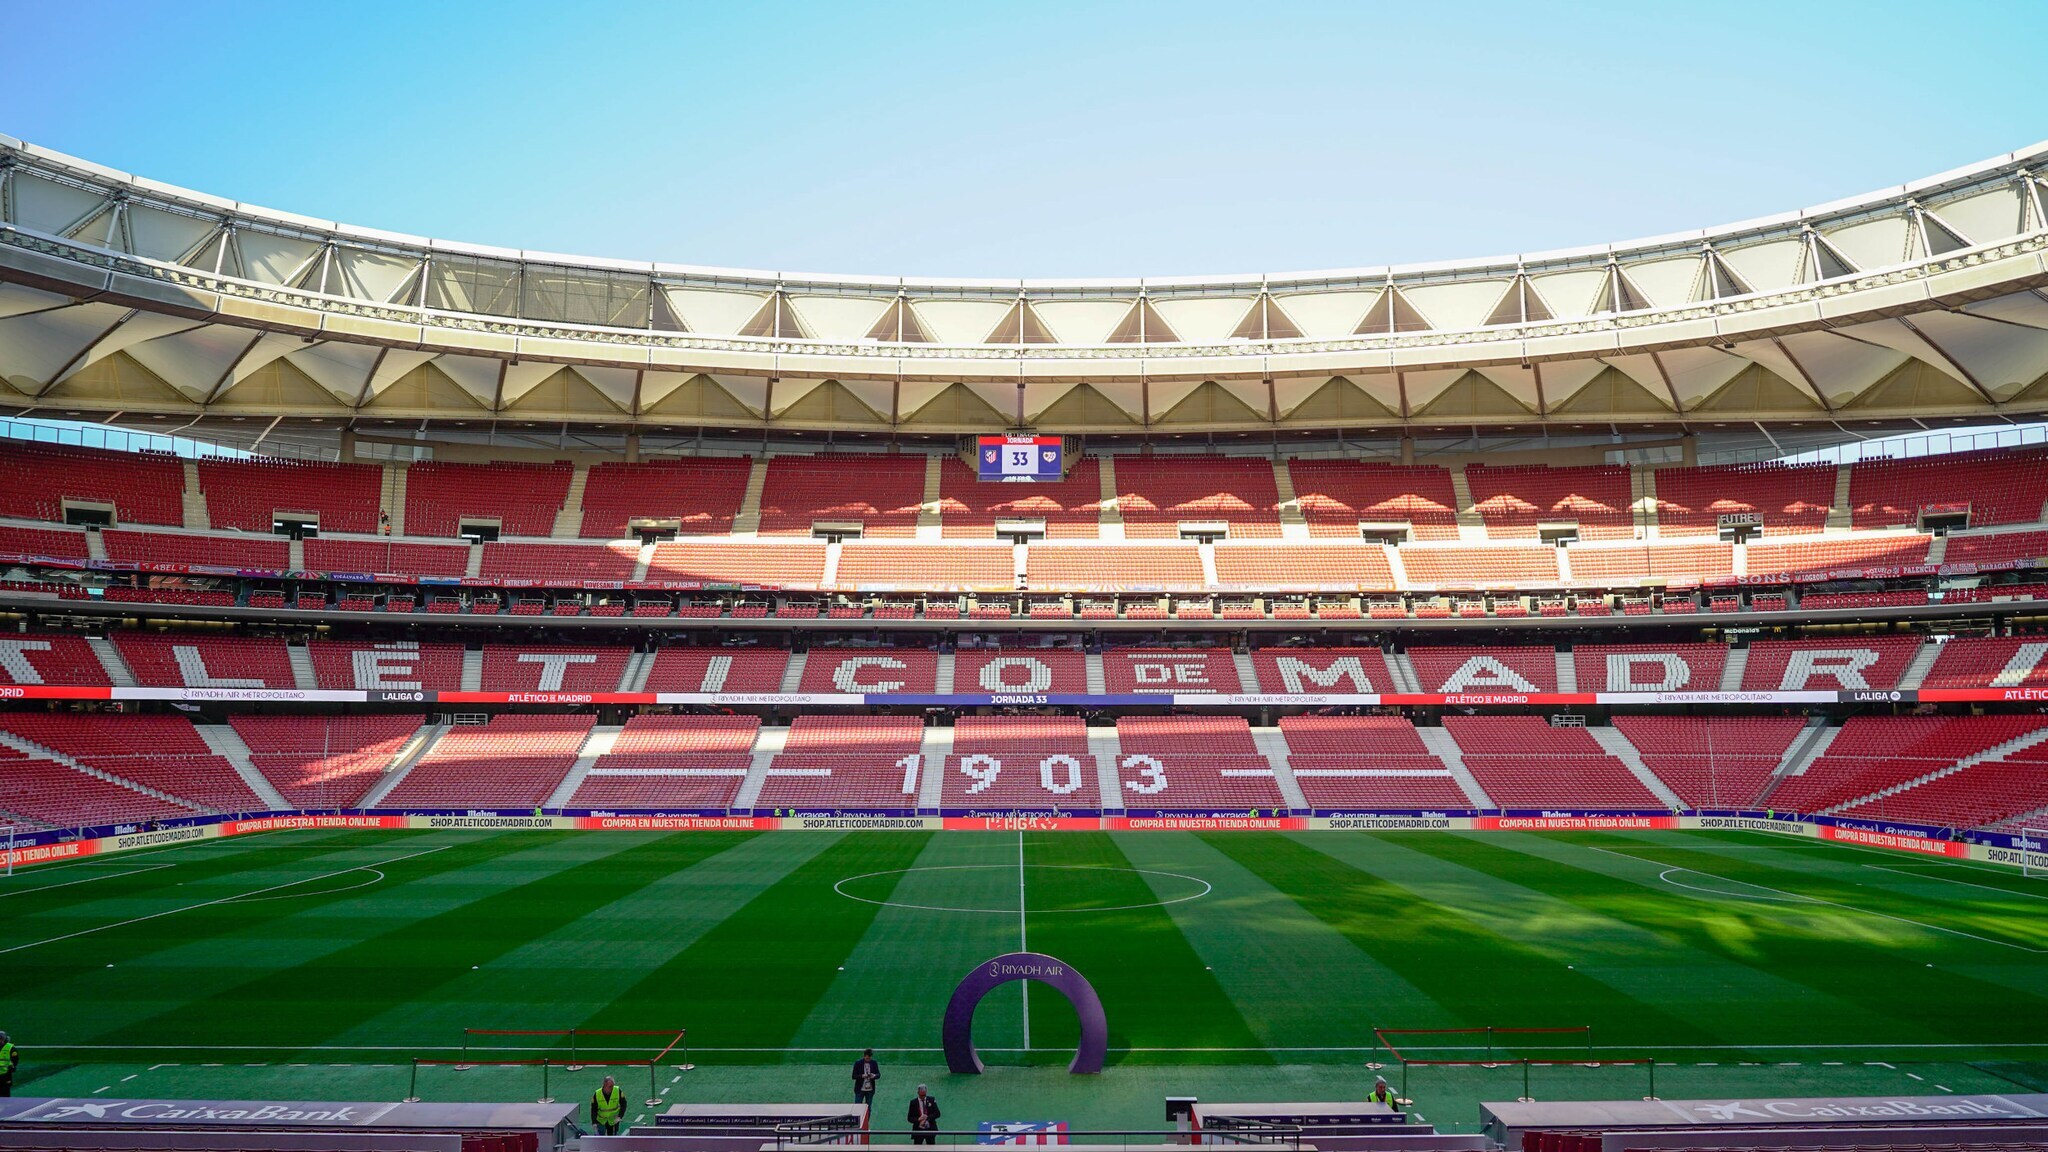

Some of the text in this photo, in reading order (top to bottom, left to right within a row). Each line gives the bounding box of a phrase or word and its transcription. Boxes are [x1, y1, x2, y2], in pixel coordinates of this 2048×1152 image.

[1012, 451, 1028, 466] 33
[1719, 512, 1754, 525] FUTRE
[152, 563, 177, 572] ABEL
[1902, 565, 1936, 575] PALENCIA
[1134, 663, 1209, 683] DE
[190, 690, 305, 700] RIYADH AIR METROPOLITANO
[382, 692, 412, 701] LALIGA
[508, 692, 549, 703] ATLÉTICO
[557, 694, 592, 703] MADRID
[718, 695, 812, 703] RIYADH AIR METROPOLITANO
[991, 695, 1048, 705] JORNADA 33
[1445, 693, 1484, 704] ATLÉTICO
[1493, 695, 1528, 704] MADRID
[1664, 693, 1773, 702] RIYADH AIR METROPOLITANO
[1854, 691, 1889, 701] LALIGA
[236, 816, 381, 832] COMPRA EN NUESTRA TIENDA ONLINE
[430, 818, 552, 828] SHOP.ATLETICODEMADRID.COM
[602, 819, 754, 828] COMPRA EN NUESTRA TIENDA ONLINE
[803, 819, 924, 829] SHOP.ATLETICODEMADRID.COM
[1129, 819, 1281, 829] COMPRA EN NUESTRA TIENDA ONLINE
[1329, 819, 1450, 829] SHOP.ATLETICODEMADRID.COM
[1499, 818, 1651, 828] COMPRA EN NUESTRA TIENDA ONLINE
[1700, 818, 1804, 834] SHOP.ATLETICODEMADRID.COM
[114, 824, 137, 835] Maho
[1897, 828, 1928, 838] HYUNDAI
[118, 827, 204, 849] SHOP.ATLETICODEMADRID.COM
[1834, 829, 1946, 853] COMPRA EN NUESTRA TIENDA ONLINE
[22, 846, 51, 862] TIENDA
[51, 843, 79, 857] ONLINE
[1988, 848, 2048, 868] SHOP.ATLTICOD
[1001, 964, 1063, 976] RIYADH AIR
[121, 1102, 357, 1122] CaixaBank
[1765, 1100, 2009, 1118] CaixaBank
